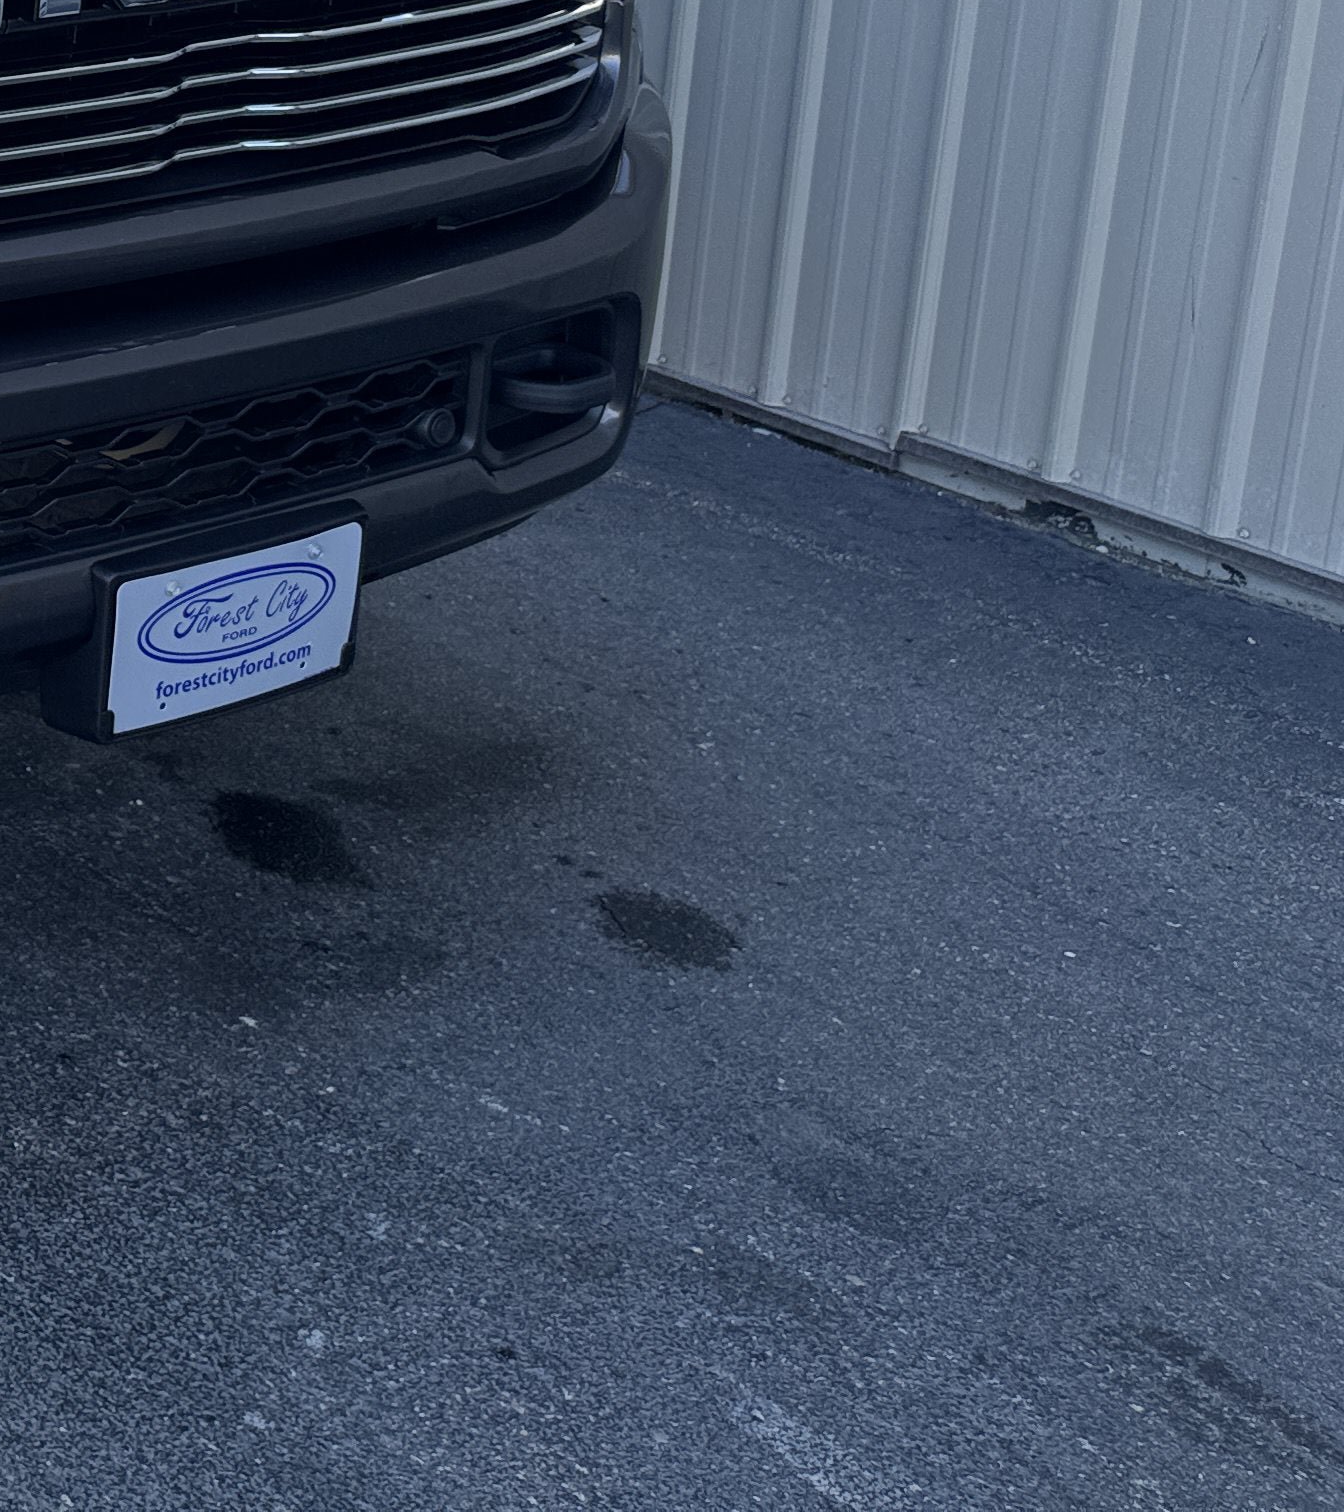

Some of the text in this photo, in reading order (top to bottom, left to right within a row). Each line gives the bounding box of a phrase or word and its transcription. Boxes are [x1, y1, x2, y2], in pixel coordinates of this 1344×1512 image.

[173, 579, 309, 639] Forest City
[221, 625, 258, 643] FORD
[155, 643, 312, 700] forestcityford.com
